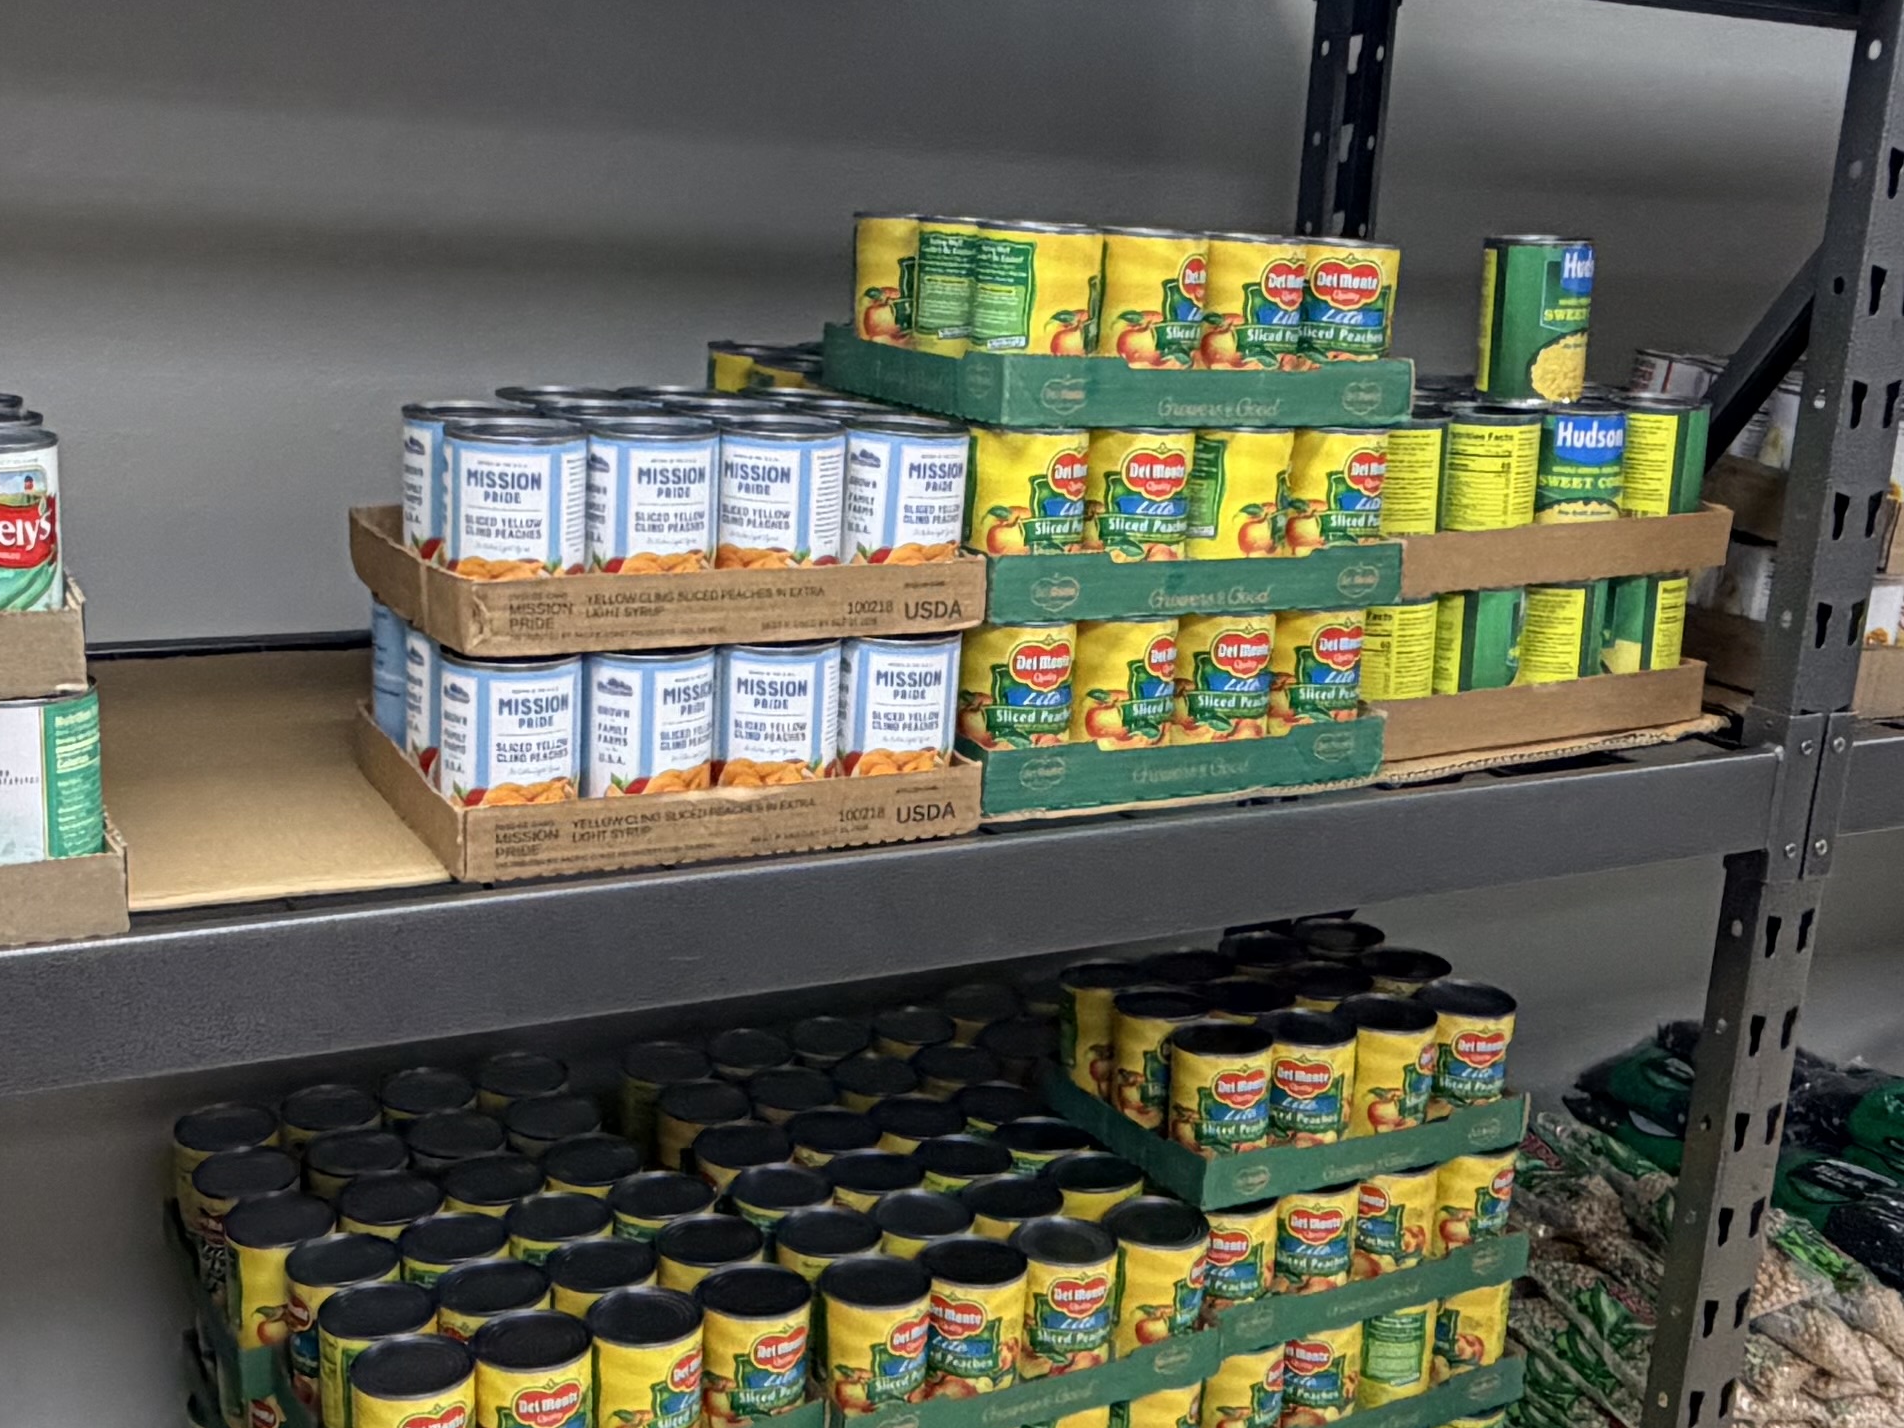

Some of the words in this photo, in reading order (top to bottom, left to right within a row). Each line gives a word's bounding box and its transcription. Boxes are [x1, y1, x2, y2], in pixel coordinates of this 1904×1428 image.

[1316, 271, 1336, 288] Del
[1339, 273, 1379, 290] Monte
[1556, 421, 1624, 448] Hudson
[466, 468, 542, 491] MISSION
[637, 466, 706, 484] MISSION
[724, 460, 791, 484] MISSION
[737, 483, 771, 496] PRIDE
[1540, 475, 1594, 489] SWEET
[483, 490, 522, 504] PRIDE
[656, 487, 691, 498] PRIDE
[904, 599, 963, 621] USDA
[875, 669, 942, 687] MISSION
[736, 677, 808, 698] MISSION
[892, 688, 926, 701] PRIDE
[498, 694, 570, 716] MISSION
[753, 697, 789, 710] PRIDE
[518, 715, 554, 729] PRIDE
[896, 801, 957, 824] USDA
[518, 1398, 539, 1414] Del
